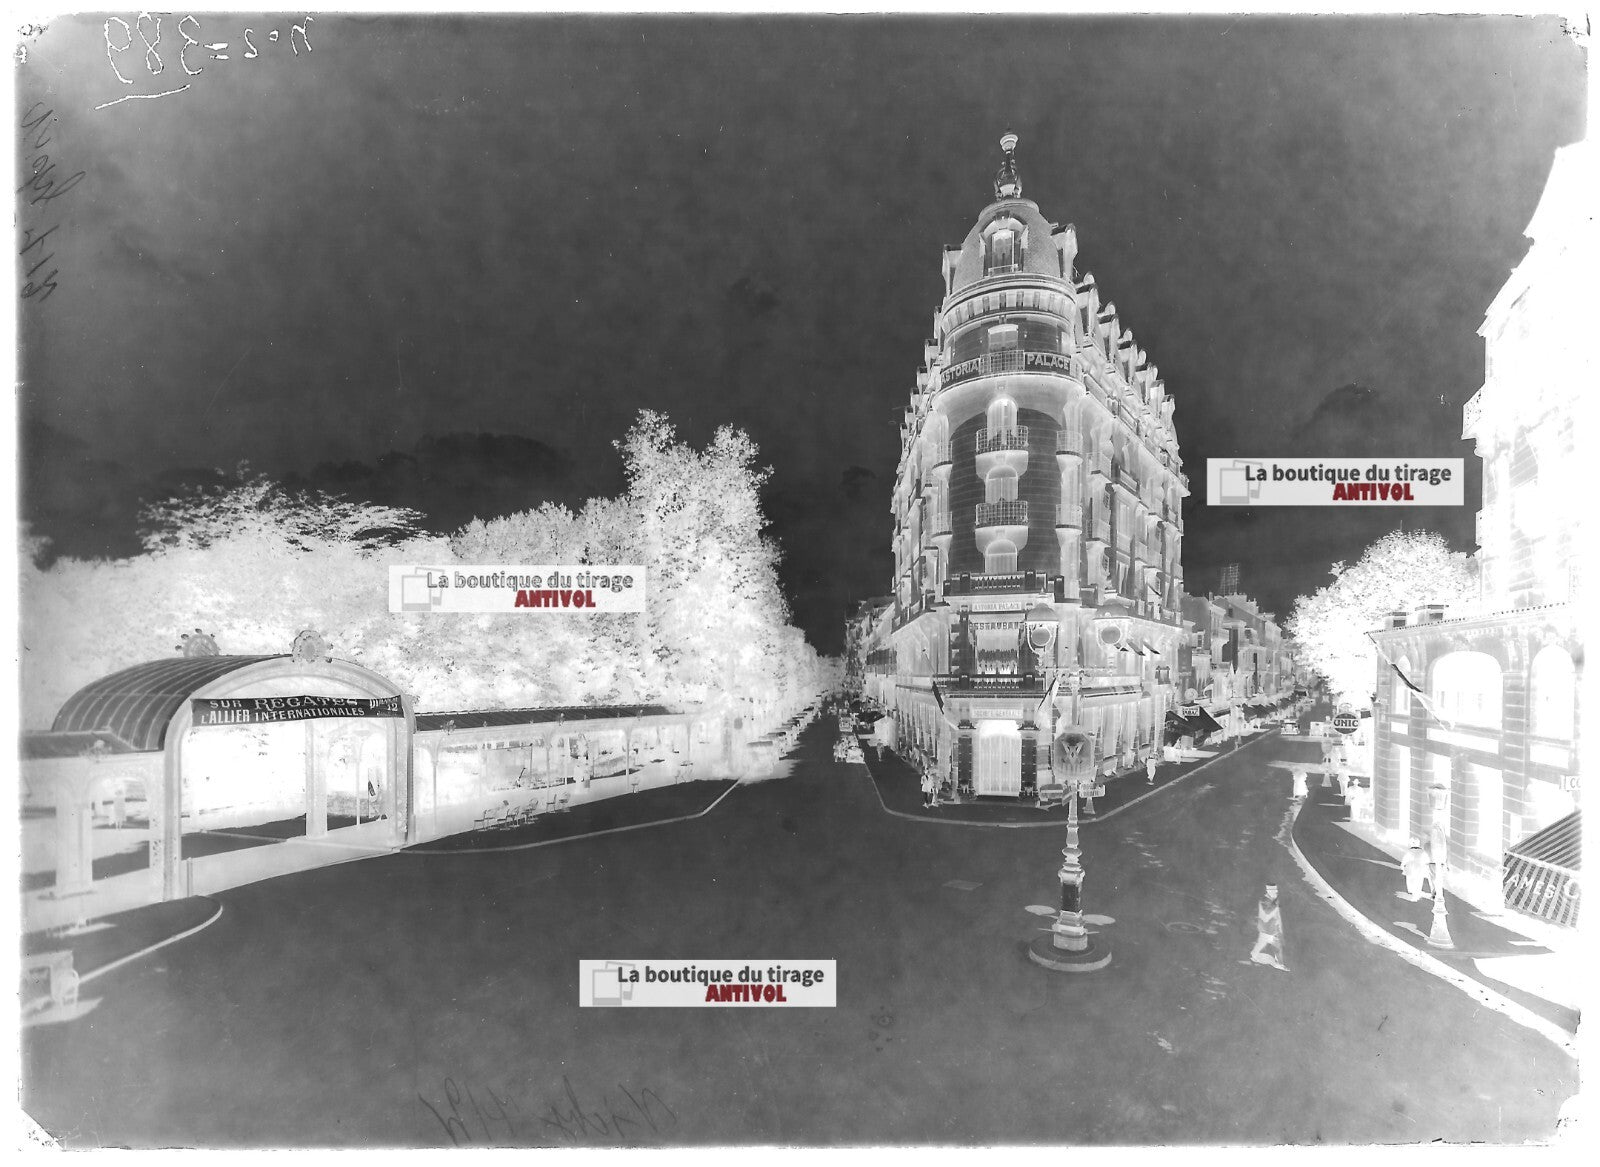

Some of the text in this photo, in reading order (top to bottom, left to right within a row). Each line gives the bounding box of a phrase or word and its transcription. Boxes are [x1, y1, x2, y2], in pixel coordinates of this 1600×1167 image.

[940, 352, 1070, 384] ASTORIA PALACE
[210, 699, 242, 709] SUR
[255, 707, 365, 722] INTERNATIONALES
[1333, 719, 1359, 727] UNIC
